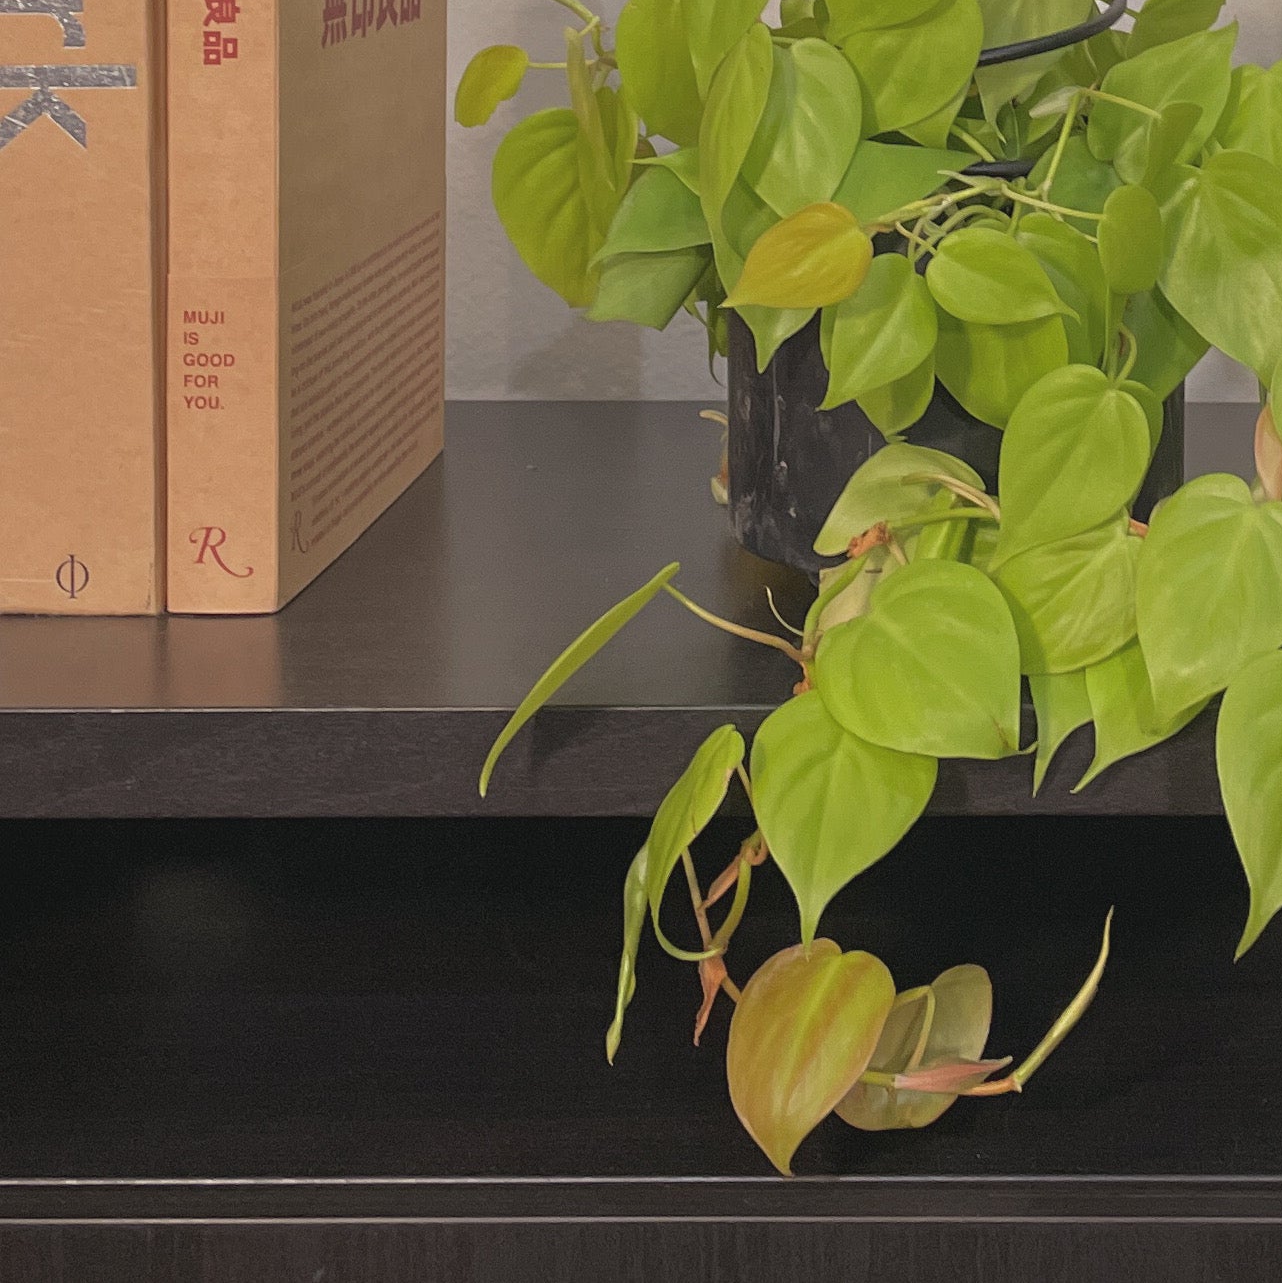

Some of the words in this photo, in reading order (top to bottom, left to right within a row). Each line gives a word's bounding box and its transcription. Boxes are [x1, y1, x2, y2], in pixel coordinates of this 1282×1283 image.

[183, 310, 225, 324] MUJI
[183, 331, 199, 345] IS
[183, 353, 235, 367] GOOD
[183, 374, 219, 388] FOR
[183, 396, 225, 410] YOU.
